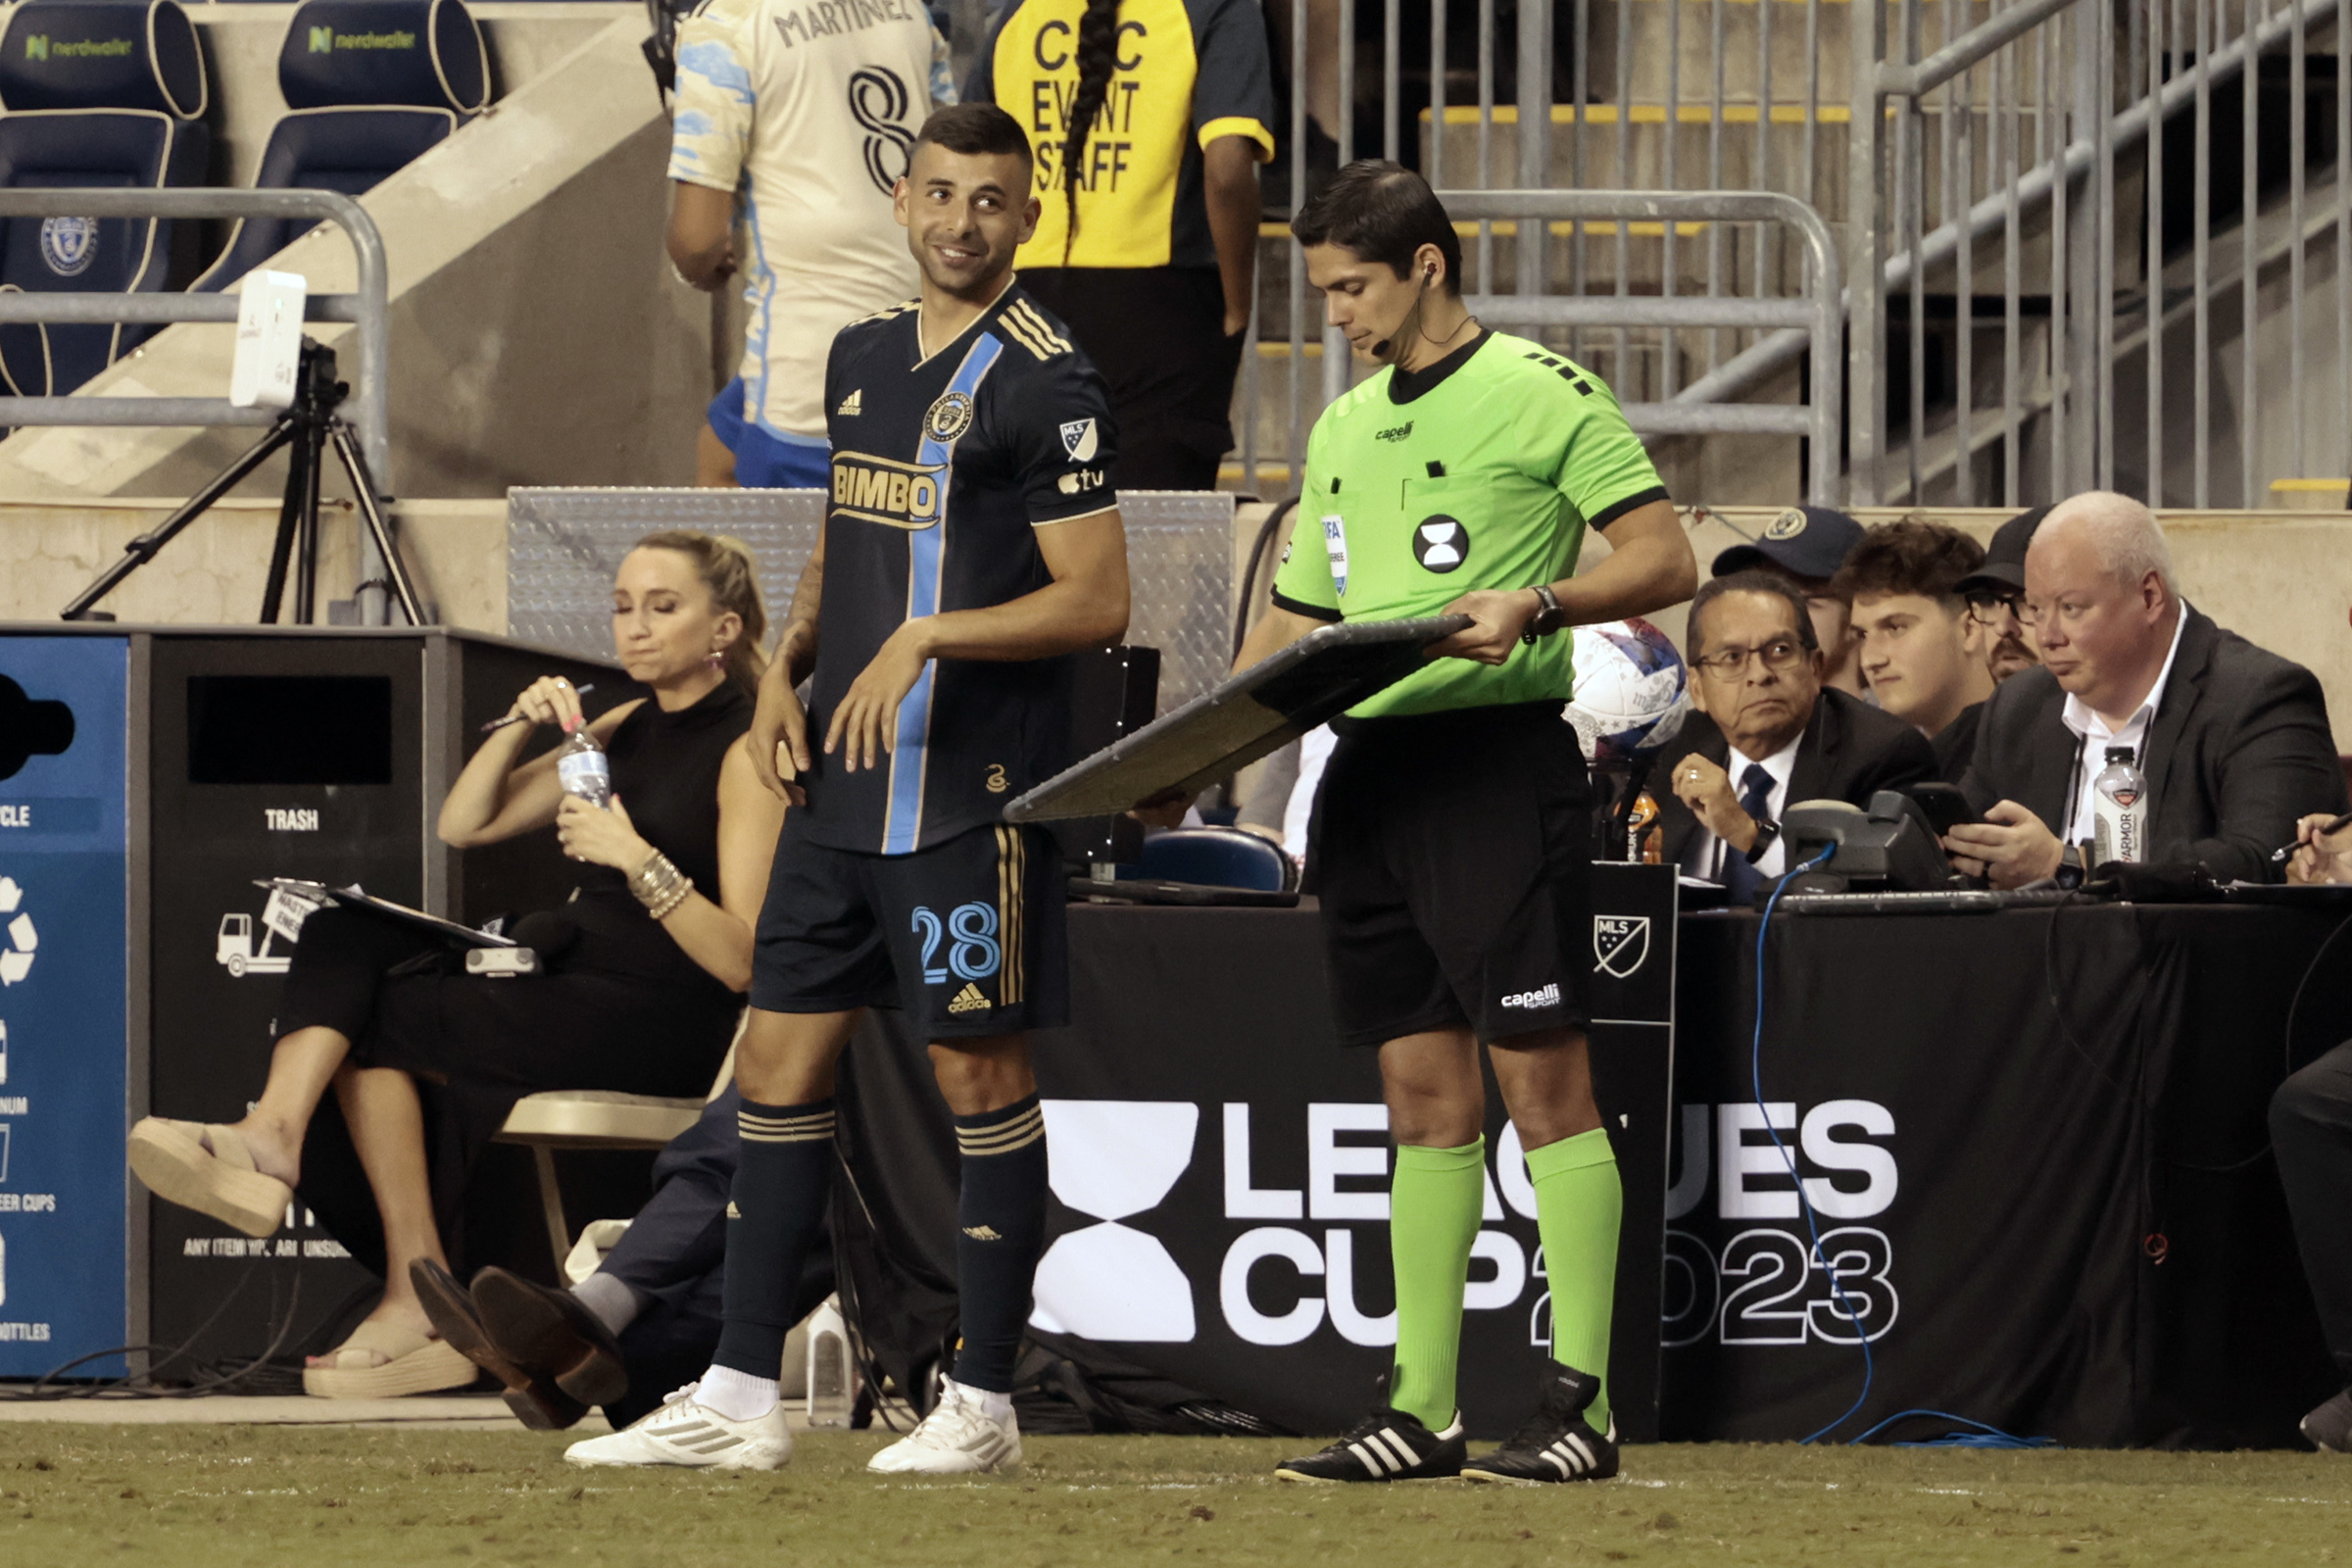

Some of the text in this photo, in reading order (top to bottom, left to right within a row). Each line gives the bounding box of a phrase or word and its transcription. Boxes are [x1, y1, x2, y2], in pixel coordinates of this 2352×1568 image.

[1035, 21, 1147, 71] CC
[1034, 80, 1140, 132] EVNT
[849, 65, 918, 197] 8
[1063, 423, 1084, 435] MLS
[833, 465, 938, 518] BIMBO
[1080, 468, 1103, 490] tv
[266, 809, 318, 831] TRASH
[1598, 920, 1629, 934] MLS
[911, 901, 1001, 984] 28
[948, 998, 992, 1013] adidas
[1500, 983, 1560, 1008] capelli
[1223, 1100, 1898, 1220] LEES
[23, 1194, 56, 1212] CUPS
[183, 1238, 211, 1256] ANY
[213, 1238, 246, 1256] ITEM
[1220, 1226, 1526, 1347] CUP
